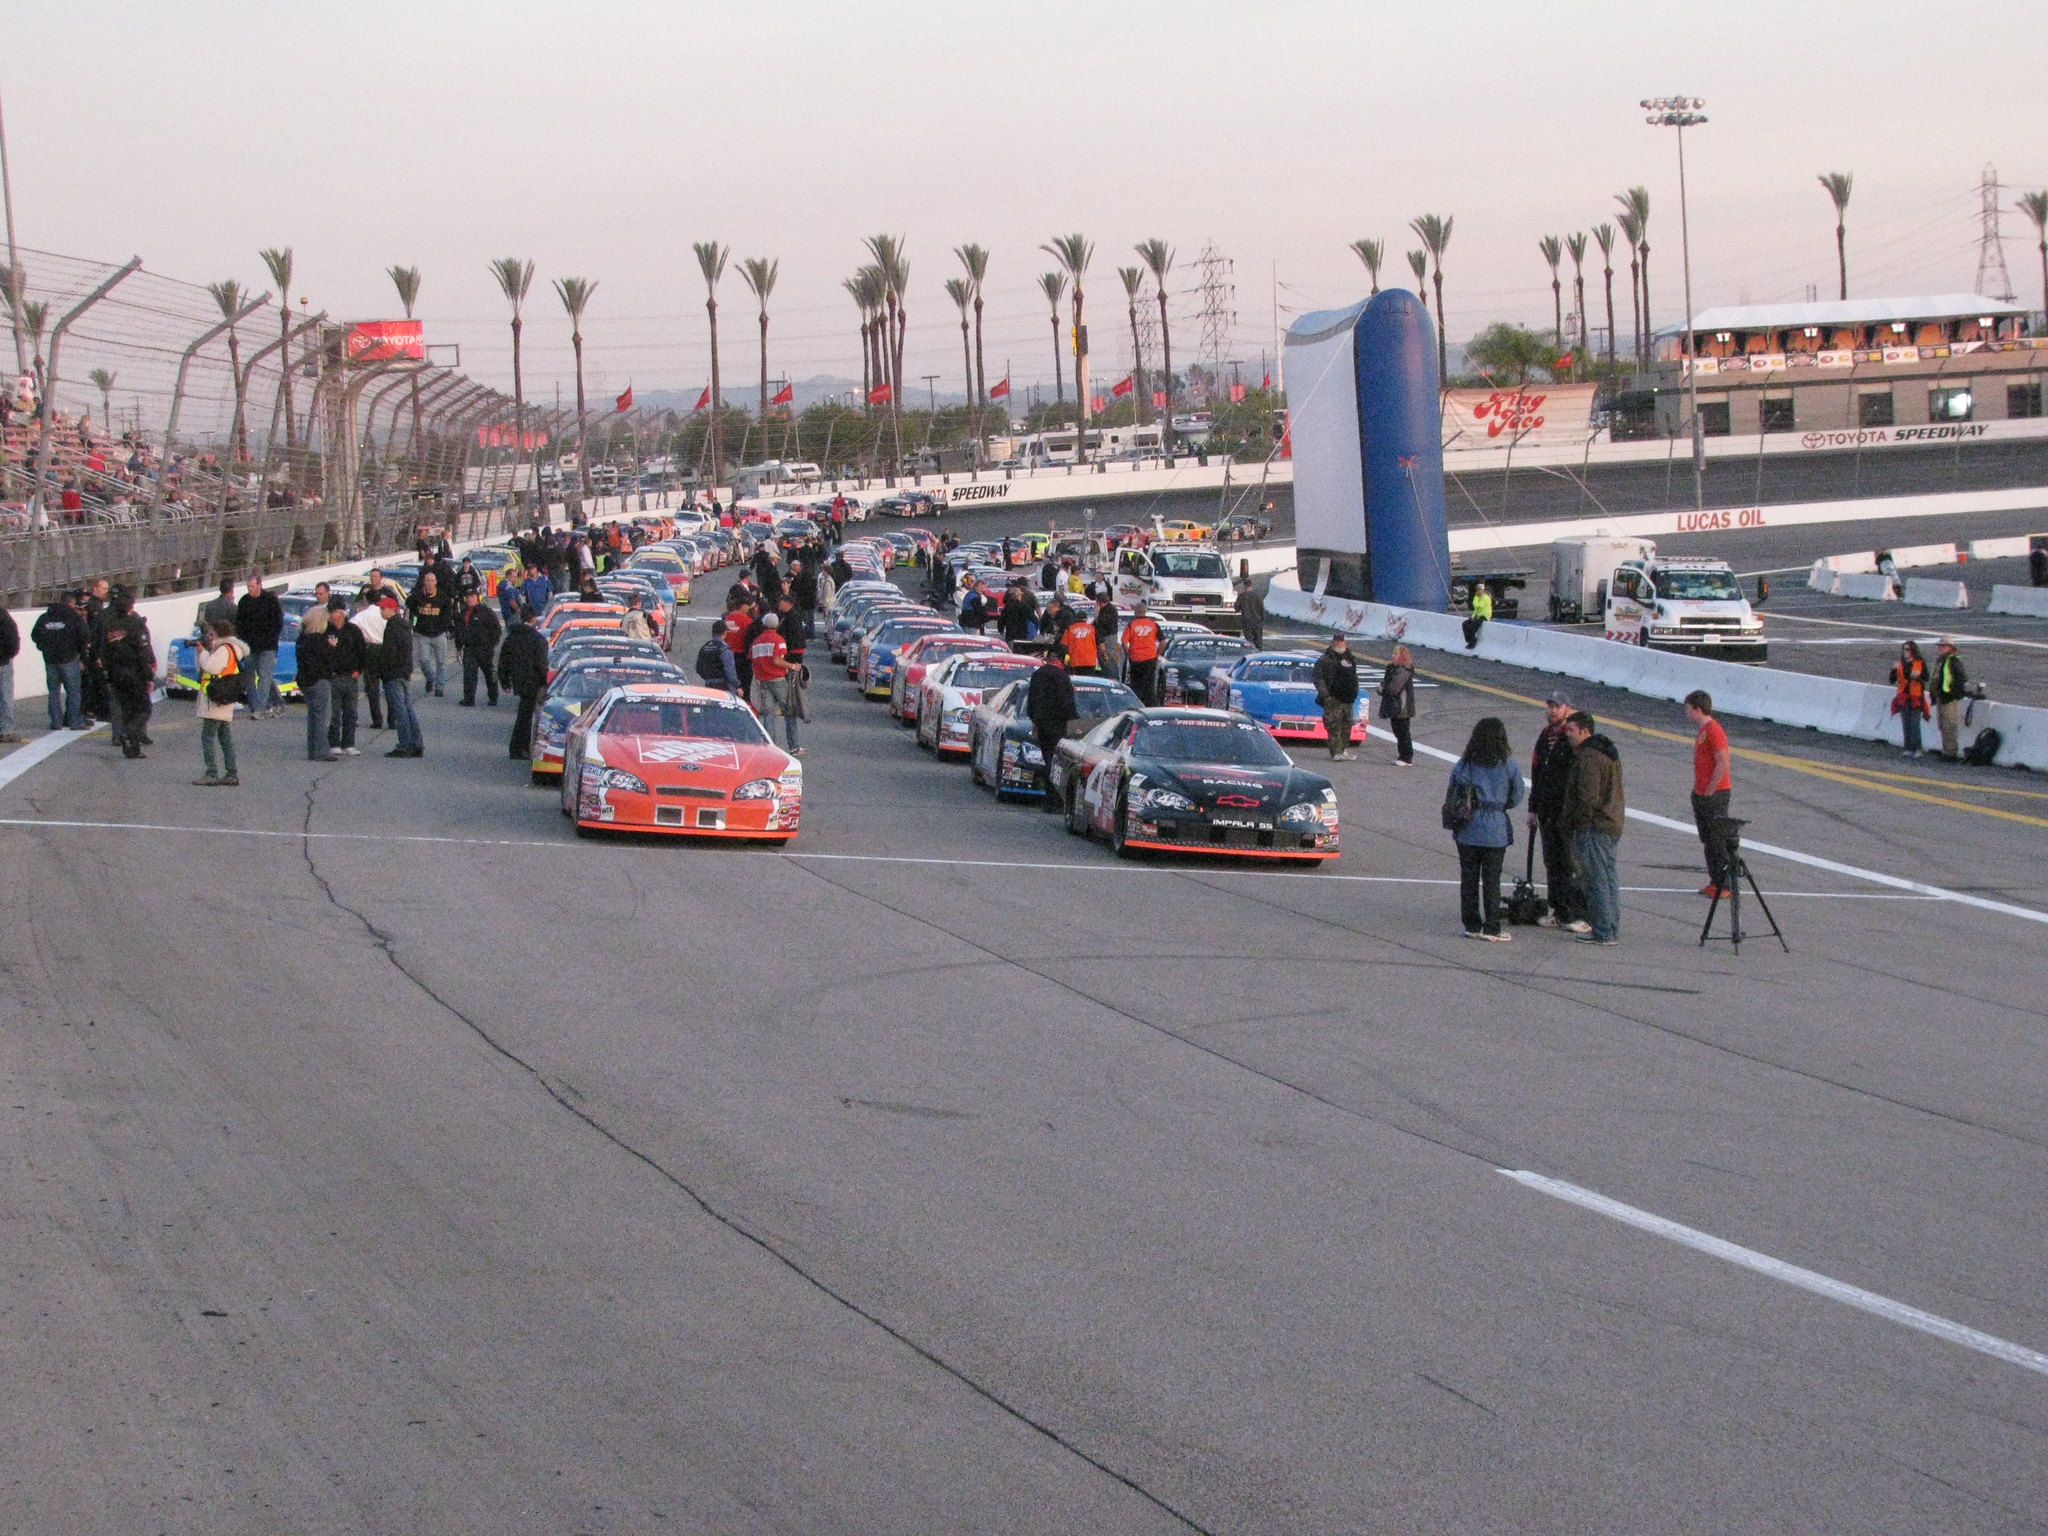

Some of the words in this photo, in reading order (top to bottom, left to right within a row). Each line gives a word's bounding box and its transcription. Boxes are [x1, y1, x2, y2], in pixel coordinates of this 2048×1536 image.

[1827, 429, 1887, 445] TOYOTA
[1894, 424, 1989, 442] SPEEDWAY
[951, 484, 1012, 501] SPEEDWAY
[1677, 510, 1731, 532] LUCAS
[1738, 508, 1766, 527] OIL
[1196, 720, 1227, 728] SERIES
[1202, 779, 1263, 789] RACING
[1212, 818, 1255, 829] IMPALA
[1258, 822, 1274, 830] SS
